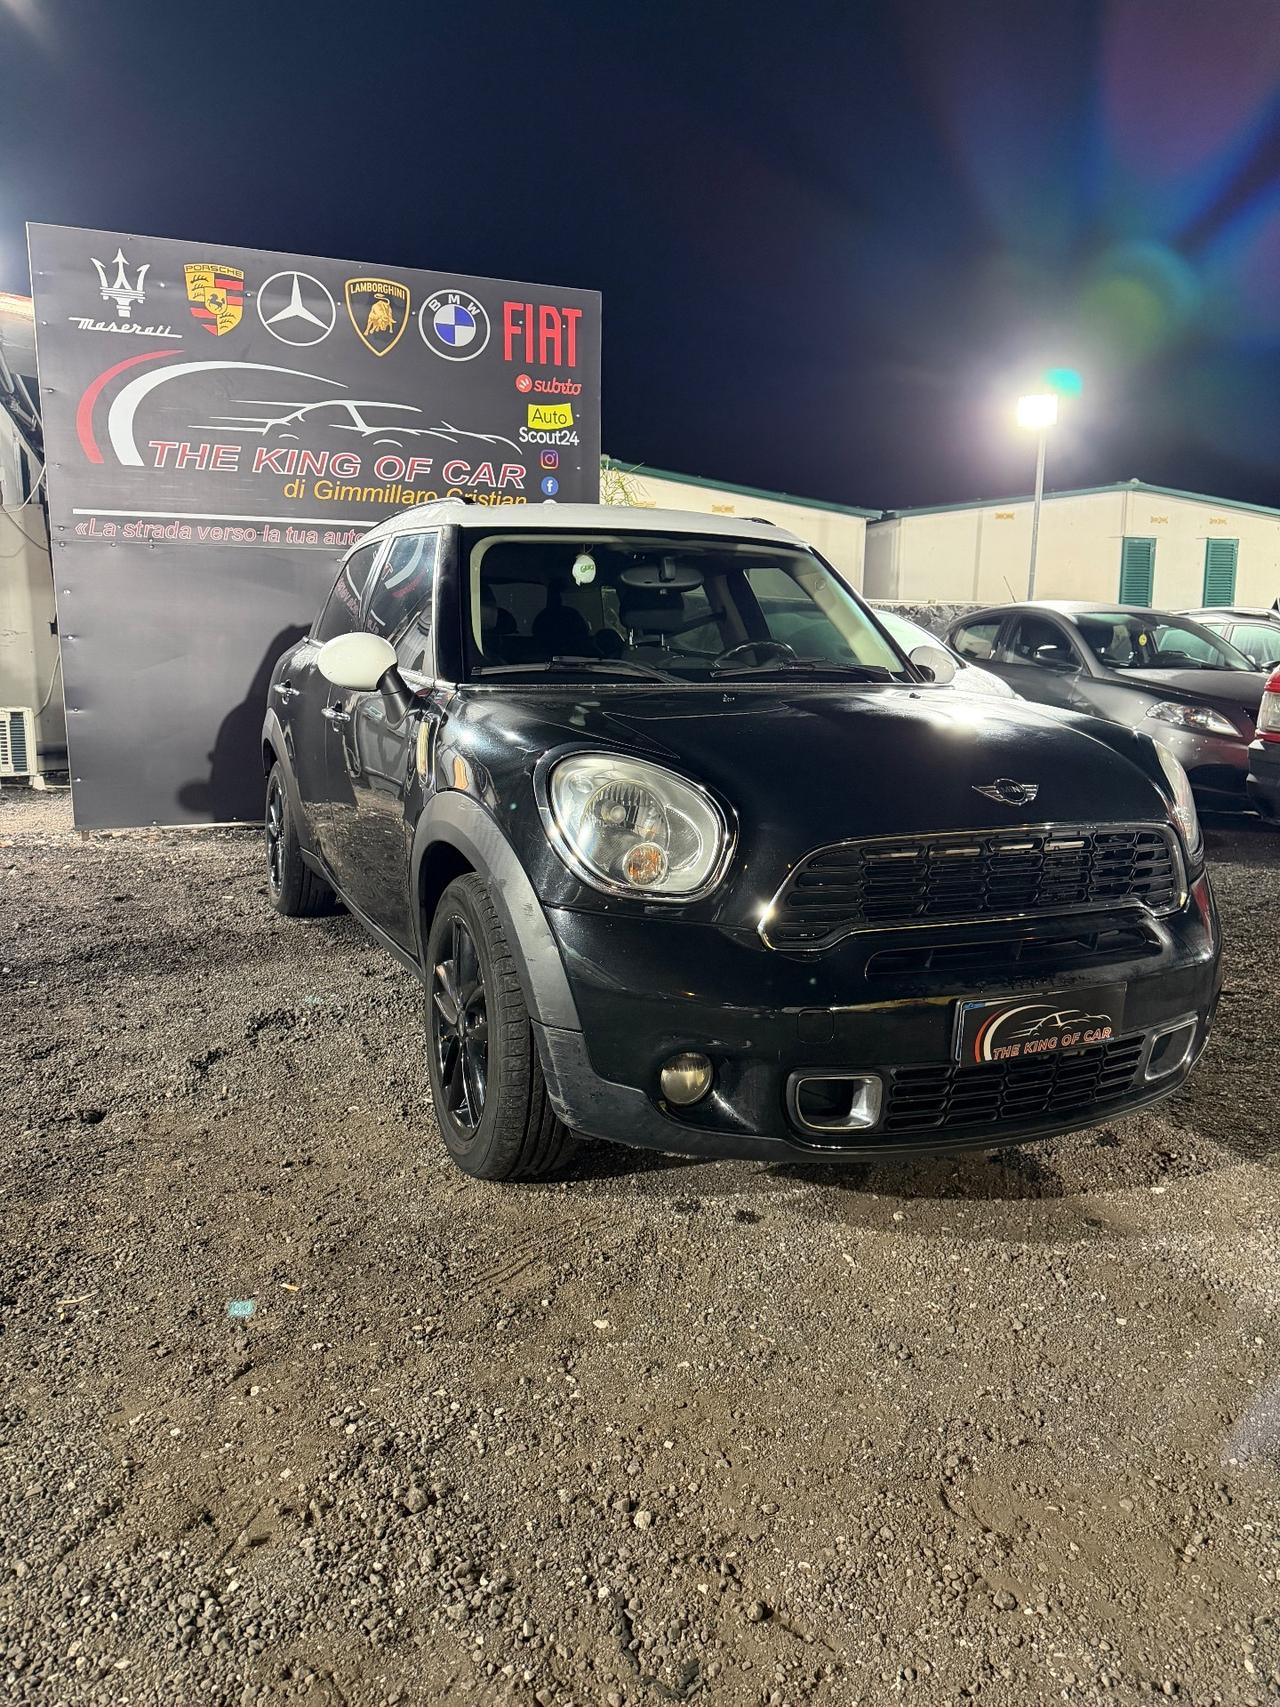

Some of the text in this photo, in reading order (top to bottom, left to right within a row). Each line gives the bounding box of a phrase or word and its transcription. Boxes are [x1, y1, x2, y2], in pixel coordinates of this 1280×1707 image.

[185, 264, 243, 277] PORSCHE
[350, 282, 406, 300] LAMBORGHINI
[428, 294, 480, 316] BMW
[504, 301, 582, 367] FIAT
[534, 377, 582, 396] subito
[532, 408, 567, 424] Auto
[519, 427, 580, 446] Scout24
[148, 440, 527, 489] THE KING OF CAR
[283, 479, 306, 498] di
[313, 479, 438, 506] Gimmillaro
[123, 520, 192, 539] strada
[197, 525, 257, 542] verso
[263, 525, 281, 543] la
[285, 526, 318, 544] tua
[993, 1044, 1021, 1060] THE
[1023, 1036, 1058, 1054] KING
[1061, 1032, 1080, 1046] OF
[1083, 1027, 1112, 1042] CAR
